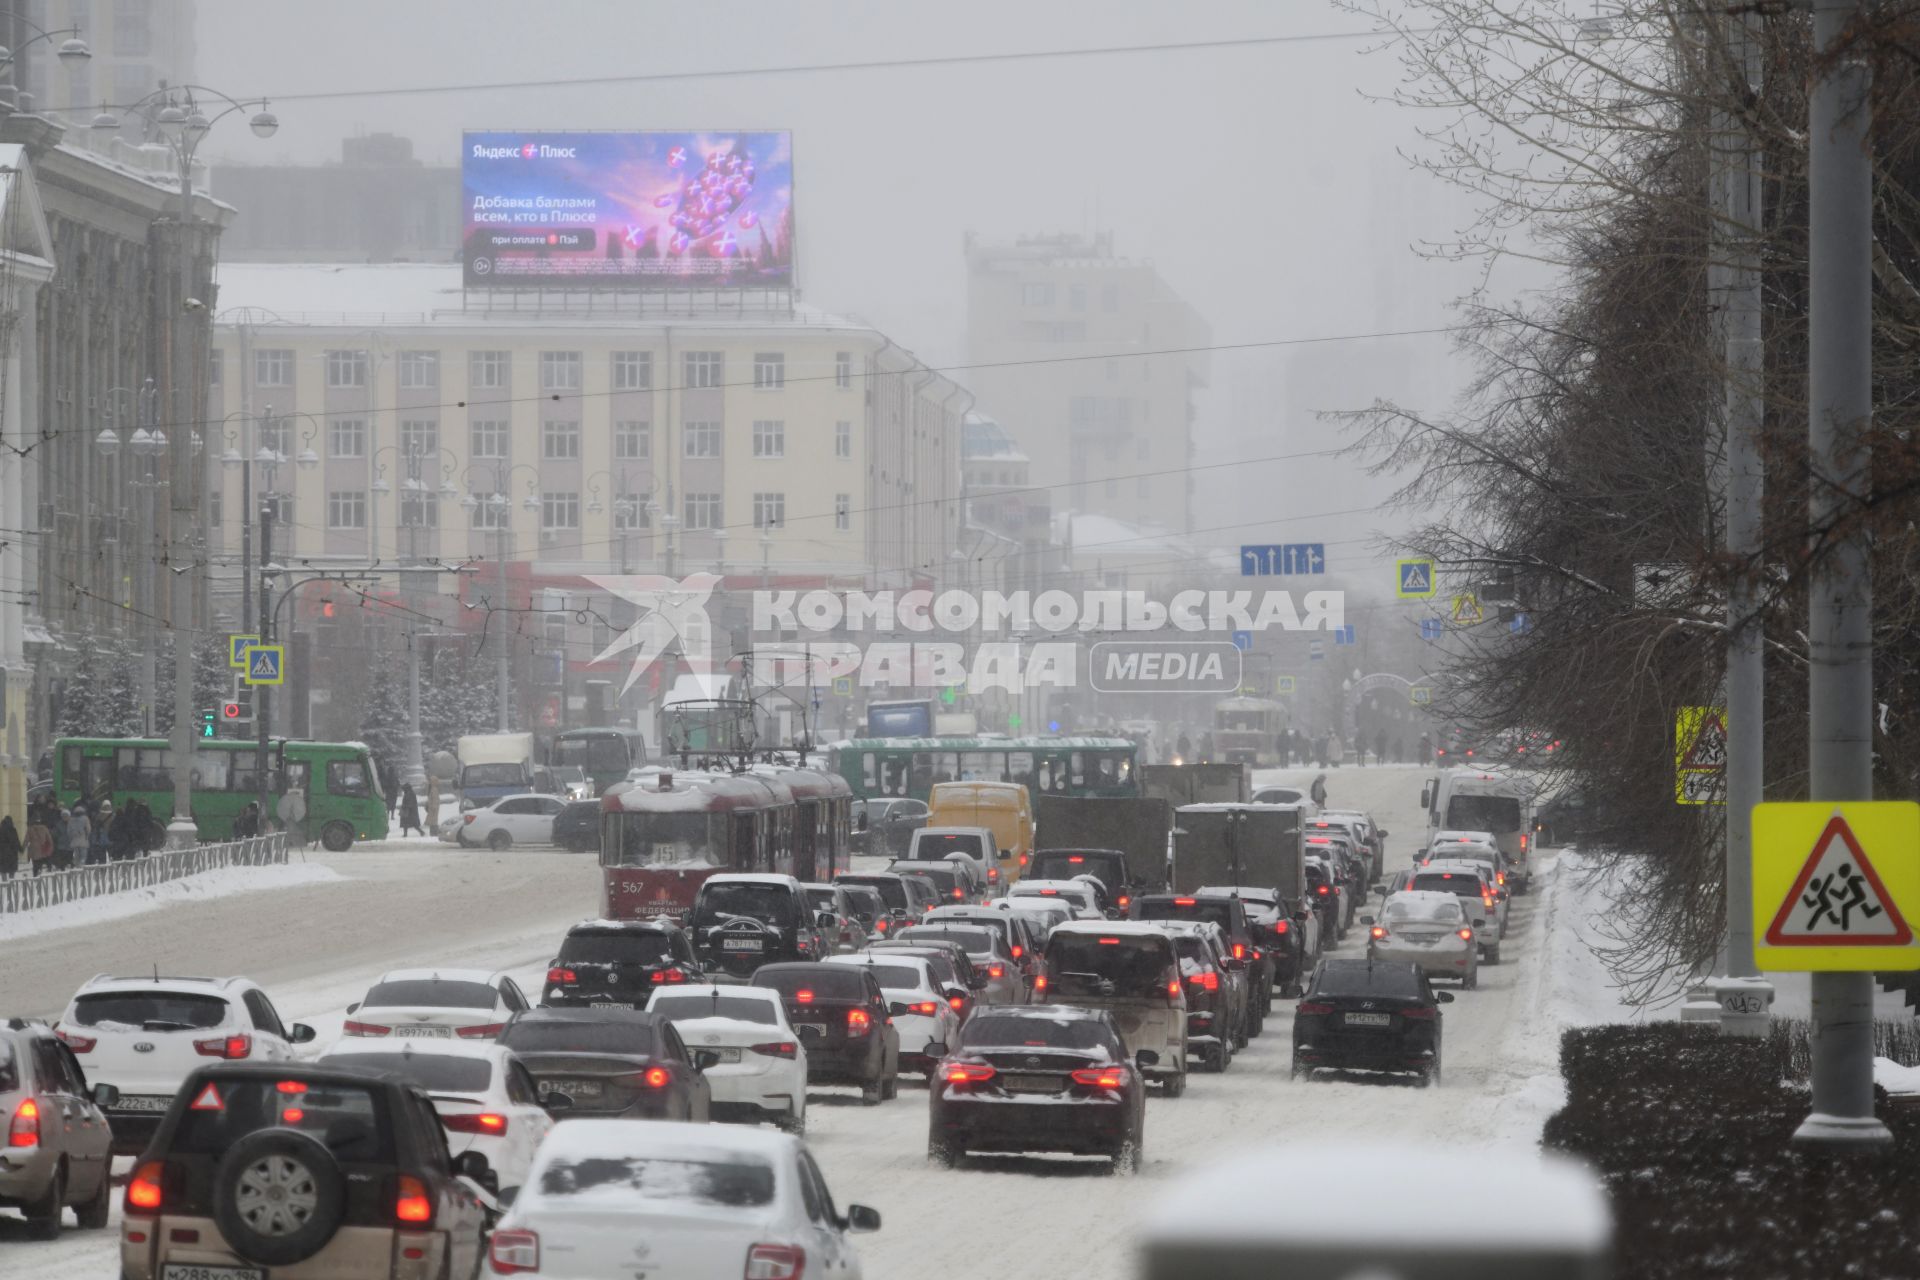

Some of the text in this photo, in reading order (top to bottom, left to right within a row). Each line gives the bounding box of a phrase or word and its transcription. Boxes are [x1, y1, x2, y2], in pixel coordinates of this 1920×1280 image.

[473, 145, 576, 159] Яндекс Плюс
[473, 196, 596, 210] Добавка баллами
[473, 211, 596, 224] всем, кто в Плюсе
[491, 236, 579, 245] при оплате Пэй
[622, 882, 644, 894] 567
